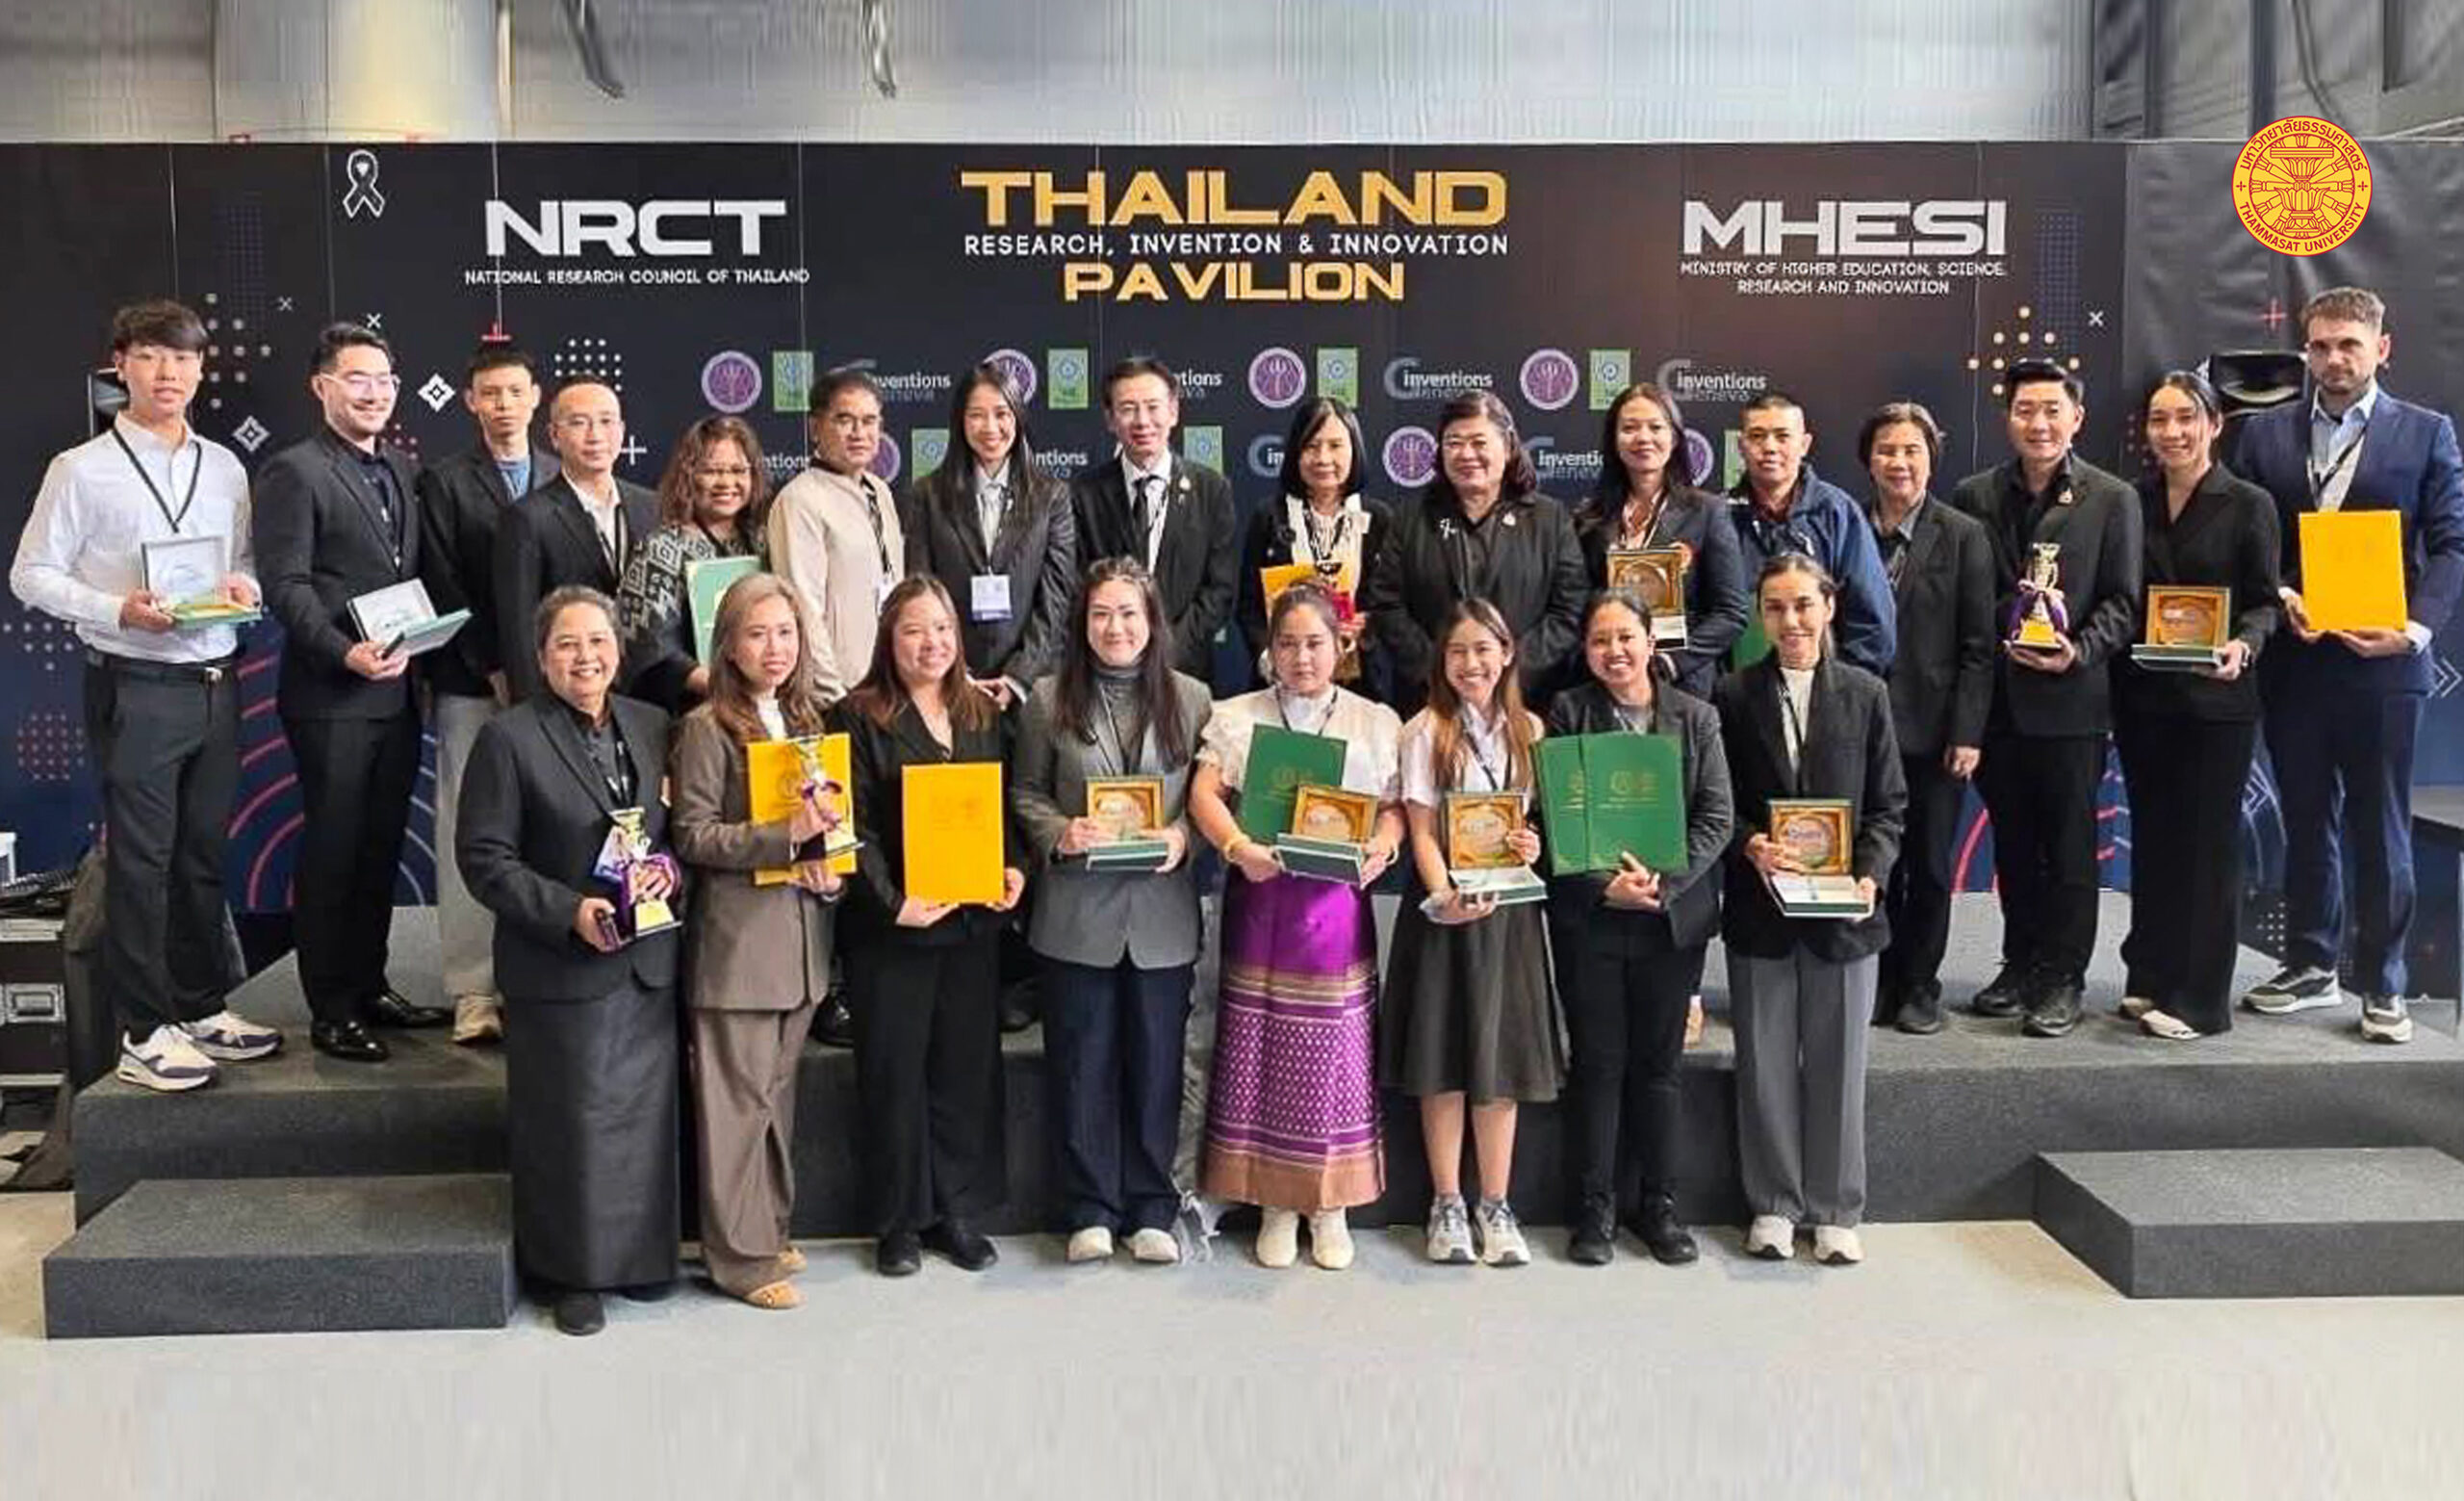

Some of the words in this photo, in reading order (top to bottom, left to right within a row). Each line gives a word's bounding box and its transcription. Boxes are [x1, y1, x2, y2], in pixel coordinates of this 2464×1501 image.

[962, 170, 1508, 226] THAILAND
[485, 199, 786, 256] NRCT
[1683, 200, 2008, 255] MHESI
[964, 234, 1115, 256] RESEARCH,
[1129, 233, 1282, 254] INVENTION
[1298, 234, 1314, 254] &
[1329, 233, 1508, 255] INNOVATION
[465, 269, 542, 285] NATIONAL
[547, 269, 625, 285] RESEARCH
[629, 269, 702, 285] COUNCIL
[706, 269, 730, 284] OF
[733, 269, 810, 285] THAILAND
[1681, 261, 1751, 275] MINISTRY
[1755, 261, 1778, 274] OF
[1782, 261, 1838, 276] HIGHER
[1065, 262, 1404, 301] PAVILION
[1737, 279, 1812, 294] RESEARCH
[1817, 279, 1850, 294] AND
[1854, 279, 1950, 295] INNOVATION
[1403, 368, 1494, 388] inventions
[1677, 371, 1768, 390] inventions
[1035, 448, 1089, 467] ntions
